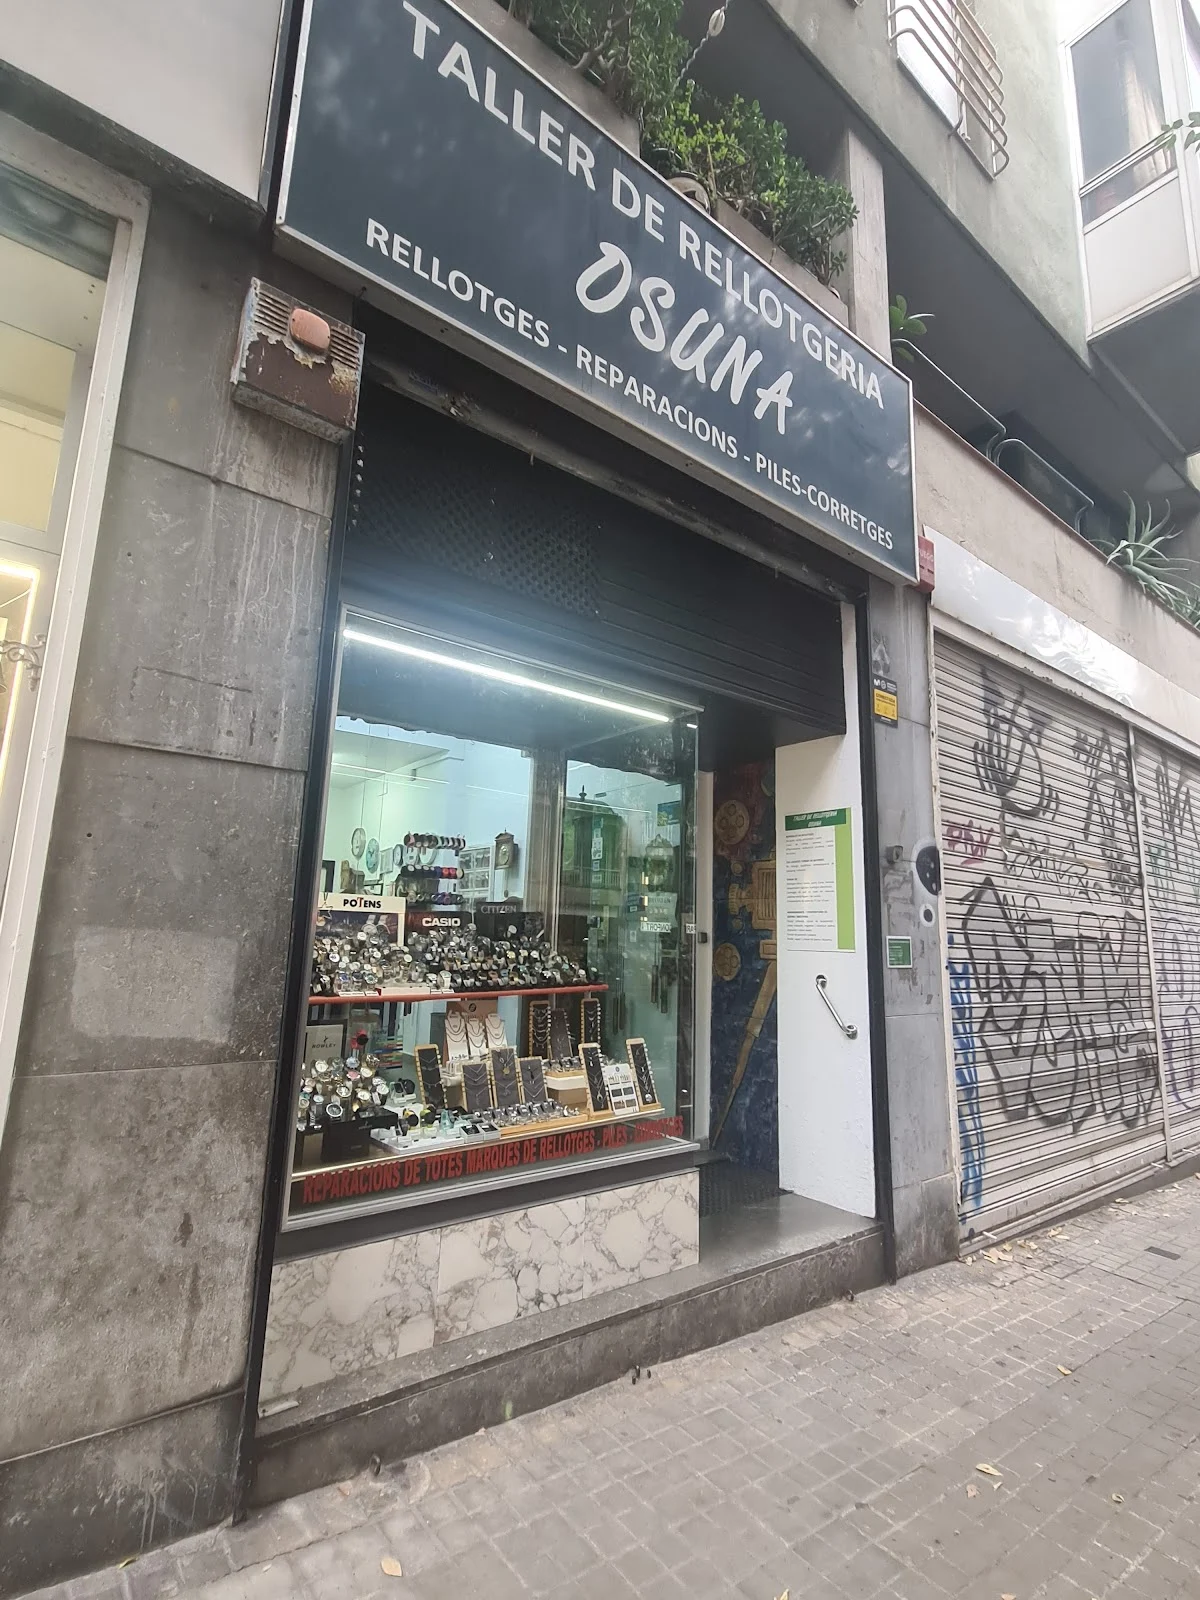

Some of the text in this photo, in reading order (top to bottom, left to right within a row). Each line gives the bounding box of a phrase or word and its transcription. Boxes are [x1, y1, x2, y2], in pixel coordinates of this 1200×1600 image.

[403, 5, 885, 409] TALLER DE RELLOTGERIA
[575, 241, 794, 435] OSUNA
[366, 218, 551, 348] RELLOTGES
[577, 343, 738, 460] REPARACIONS
[756, 451, 894, 551] PILES-CORRETGES
[343, 897, 382, 909] POTENS
[422, 917, 461, 927] CASIO
[480, 904, 517, 914] CITIZEN
[303, 1161, 400, 1204] REPARACIONS
[404, 1158, 422, 1187] DE
[426, 1150, 463, 1182] TOTES
[466, 1144, 521, 1175] MARQUES
[522, 1141, 537, 1165] DE
[539, 1129, 596, 1161] RELLOTGES
[602, 1125, 628, 1150] PILES
